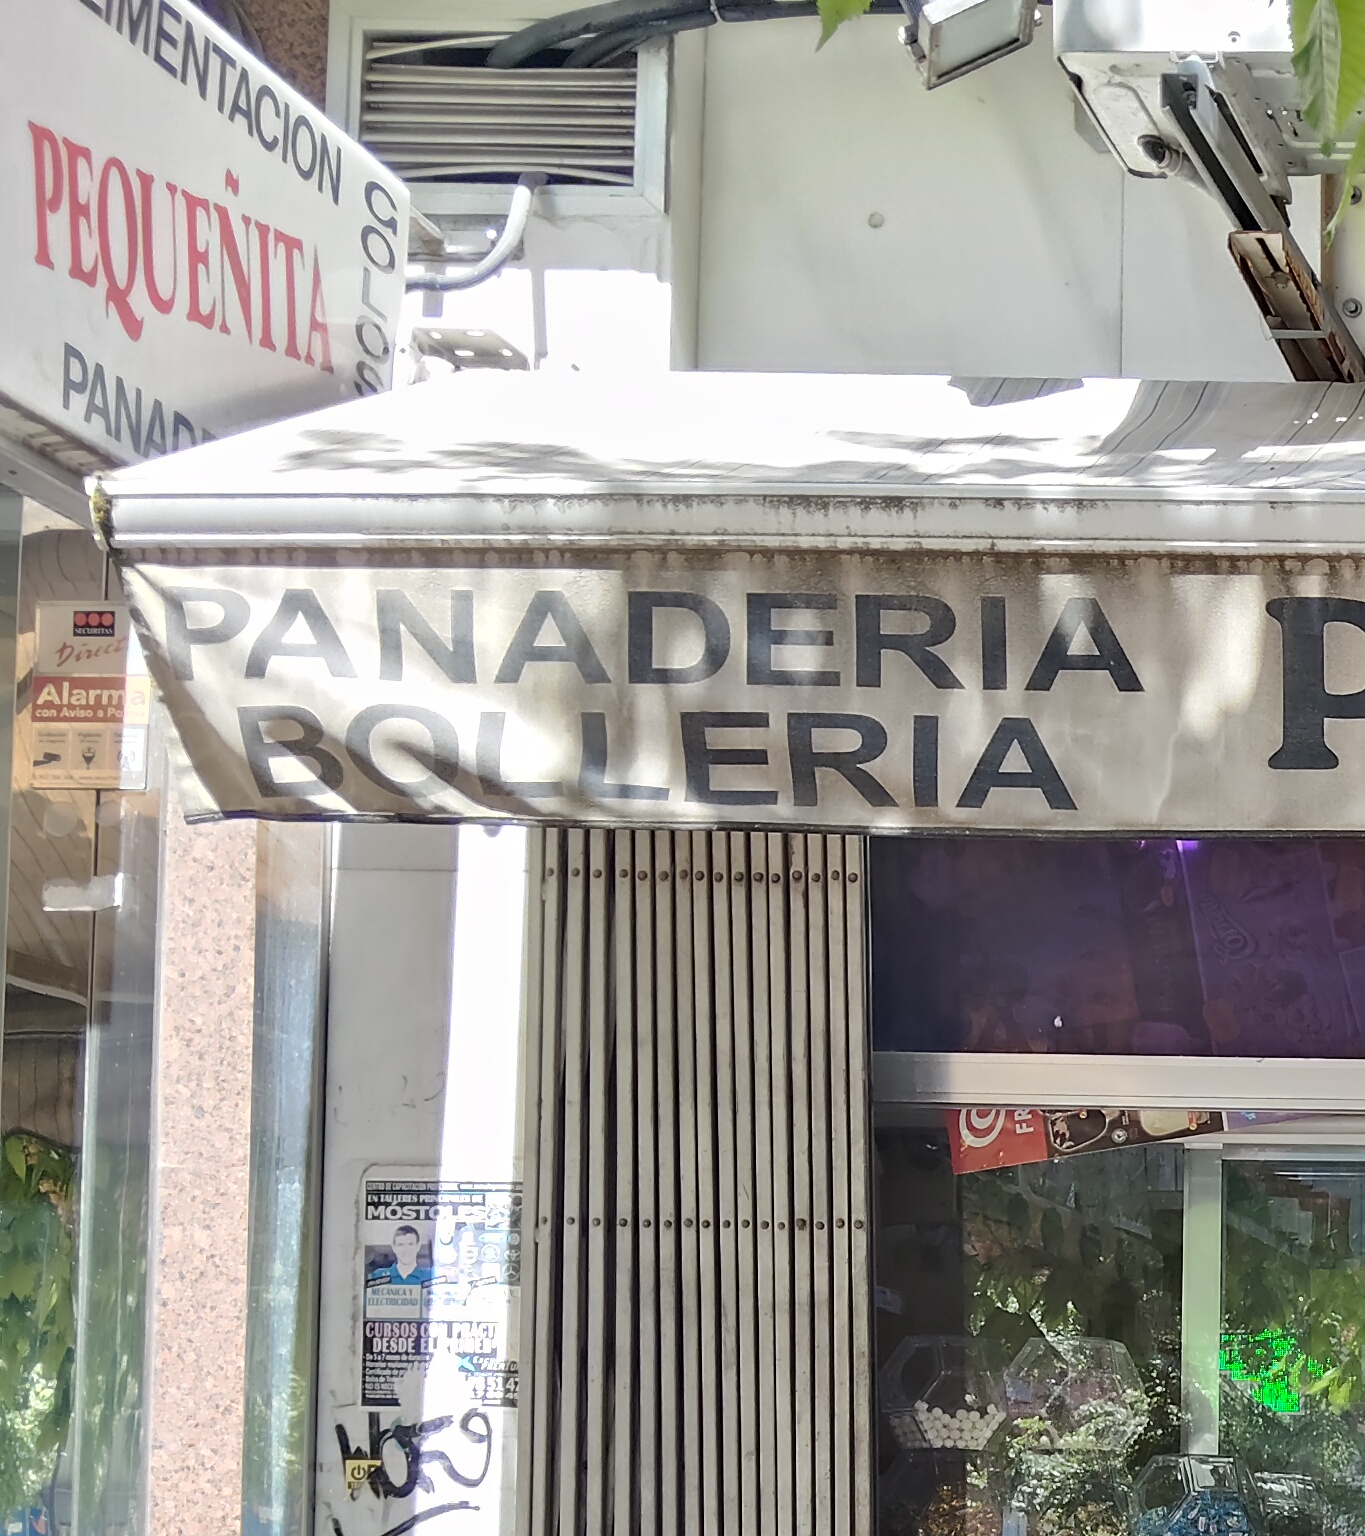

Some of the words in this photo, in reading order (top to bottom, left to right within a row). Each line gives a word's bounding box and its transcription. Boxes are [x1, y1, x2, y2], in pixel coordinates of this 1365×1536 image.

[28, 121, 334, 375] PEQUEÑITA
[56, 636, 129, 668] Direct
[163, 585, 1144, 693] PANADERIA
[36, 681, 145, 705] Alarma
[60, 706, 93, 718] Aviso
[237, 703, 1079, 811] BOLLERIA
[366, 1322, 418, 1337] CURSOS
[372, 1338, 416, 1352] DESDE
